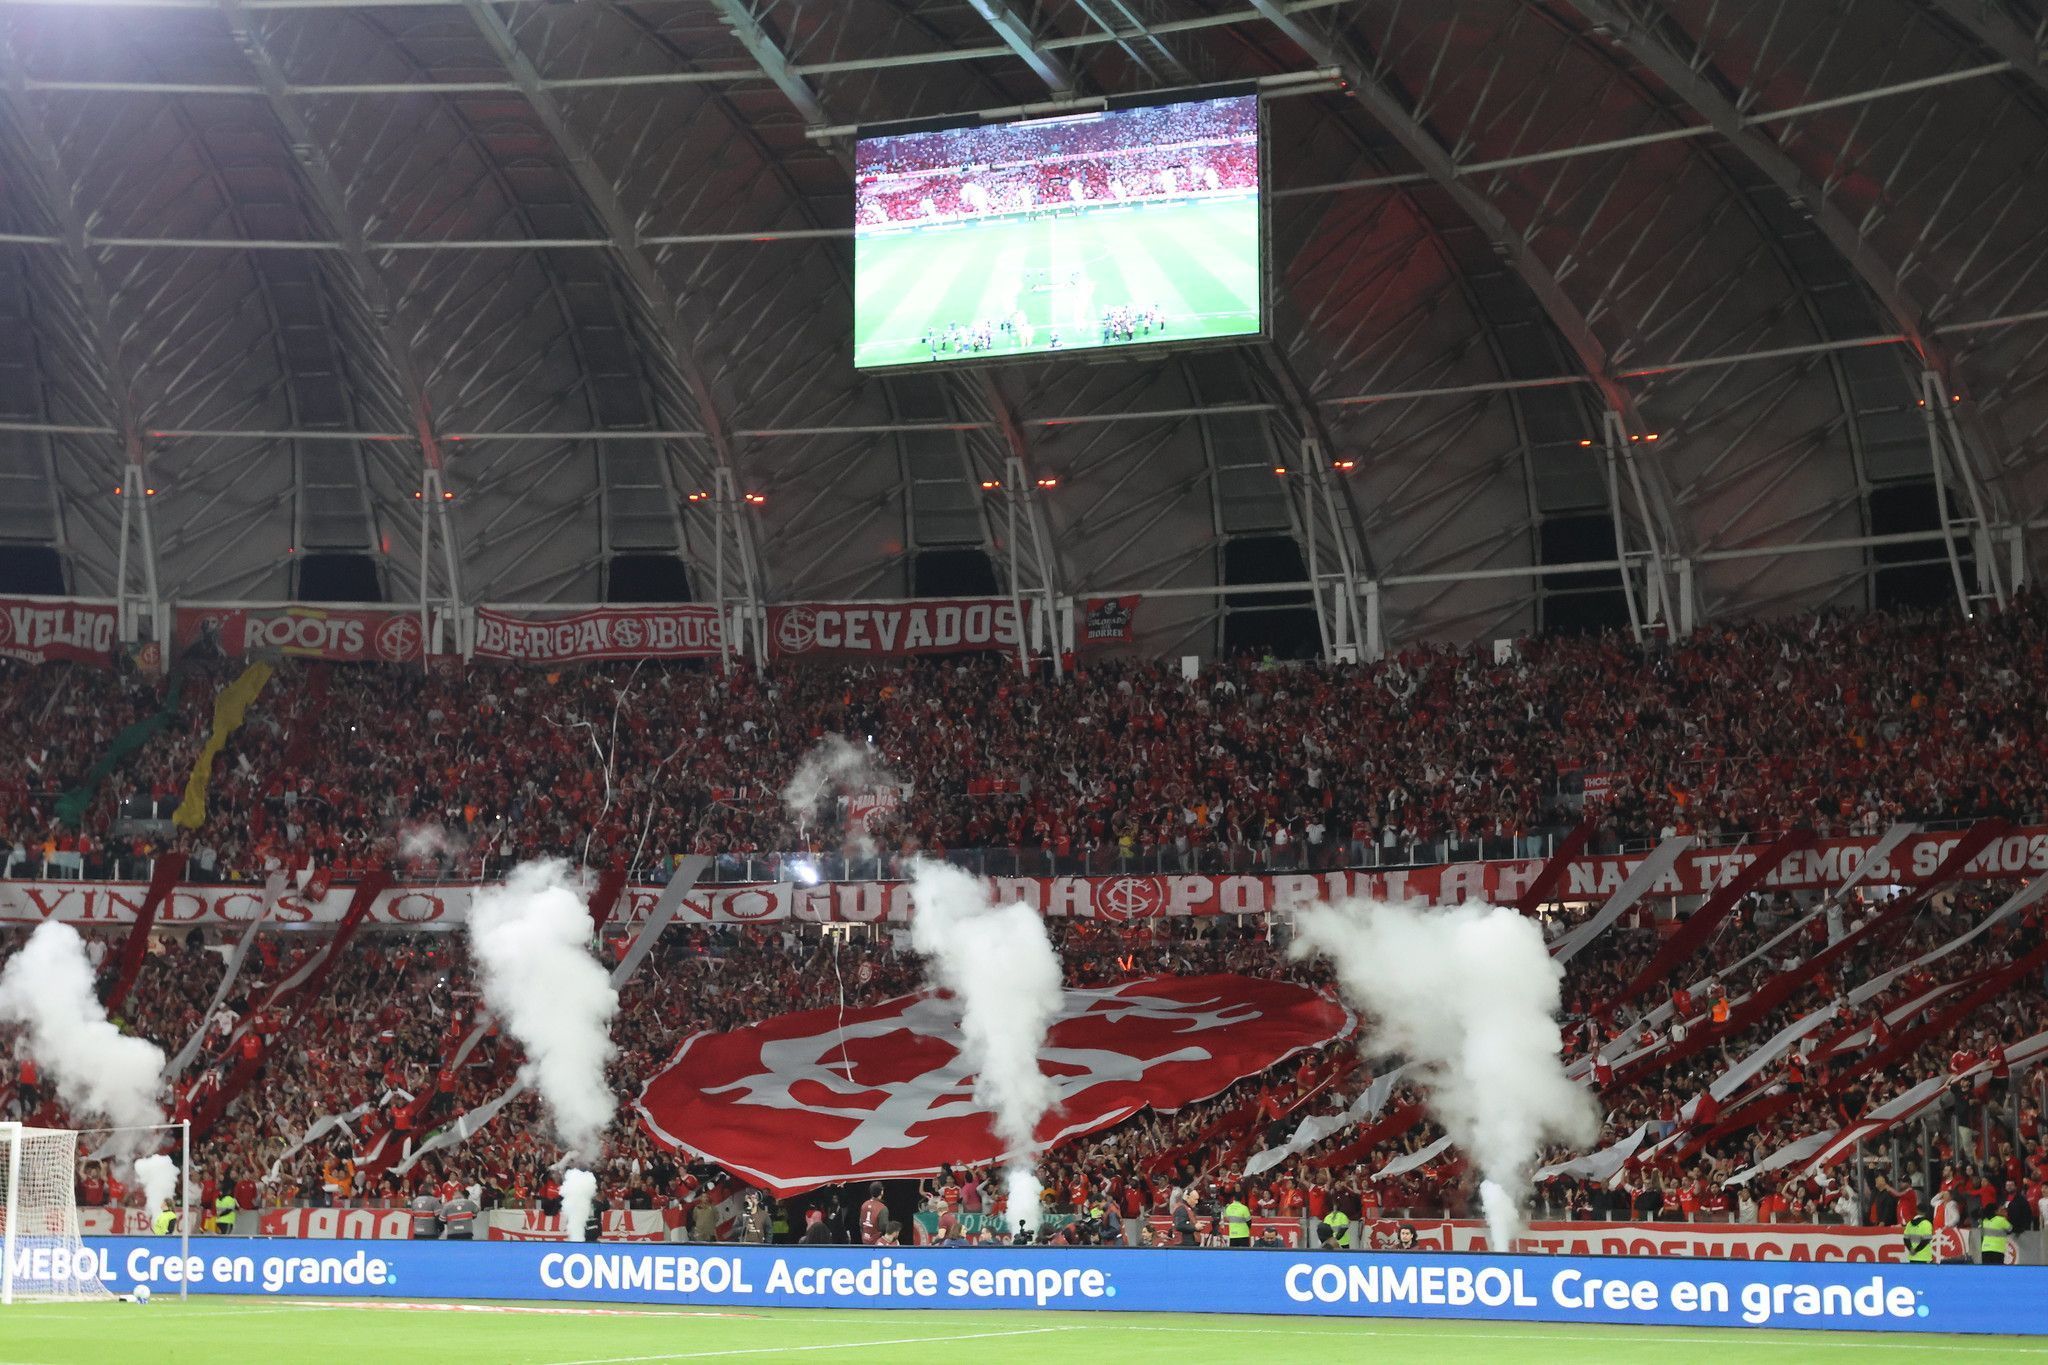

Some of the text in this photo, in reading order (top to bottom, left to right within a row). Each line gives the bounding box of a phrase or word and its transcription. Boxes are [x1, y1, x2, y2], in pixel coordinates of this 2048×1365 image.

[10, 607, 115, 652] VELHO
[244, 611, 364, 652] ROOTS
[815, 604, 1019, 651] CEVADOS
[1567, 860, 1683, 894] NAA
[22, 888, 313, 922] VINDOS
[791, 876, 1095, 924] GUADA
[127, 1247, 204, 1282] Cree
[212, 1256, 254, 1283] en
[539, 1252, 753, 1293] CONMEBOL
[764, 1257, 938, 1297] Acredite
[1285, 1263, 1538, 1307] CONMEBOL
[1551, 1269, 1659, 1311] Cree
[1670, 1281, 1729, 1312] en
